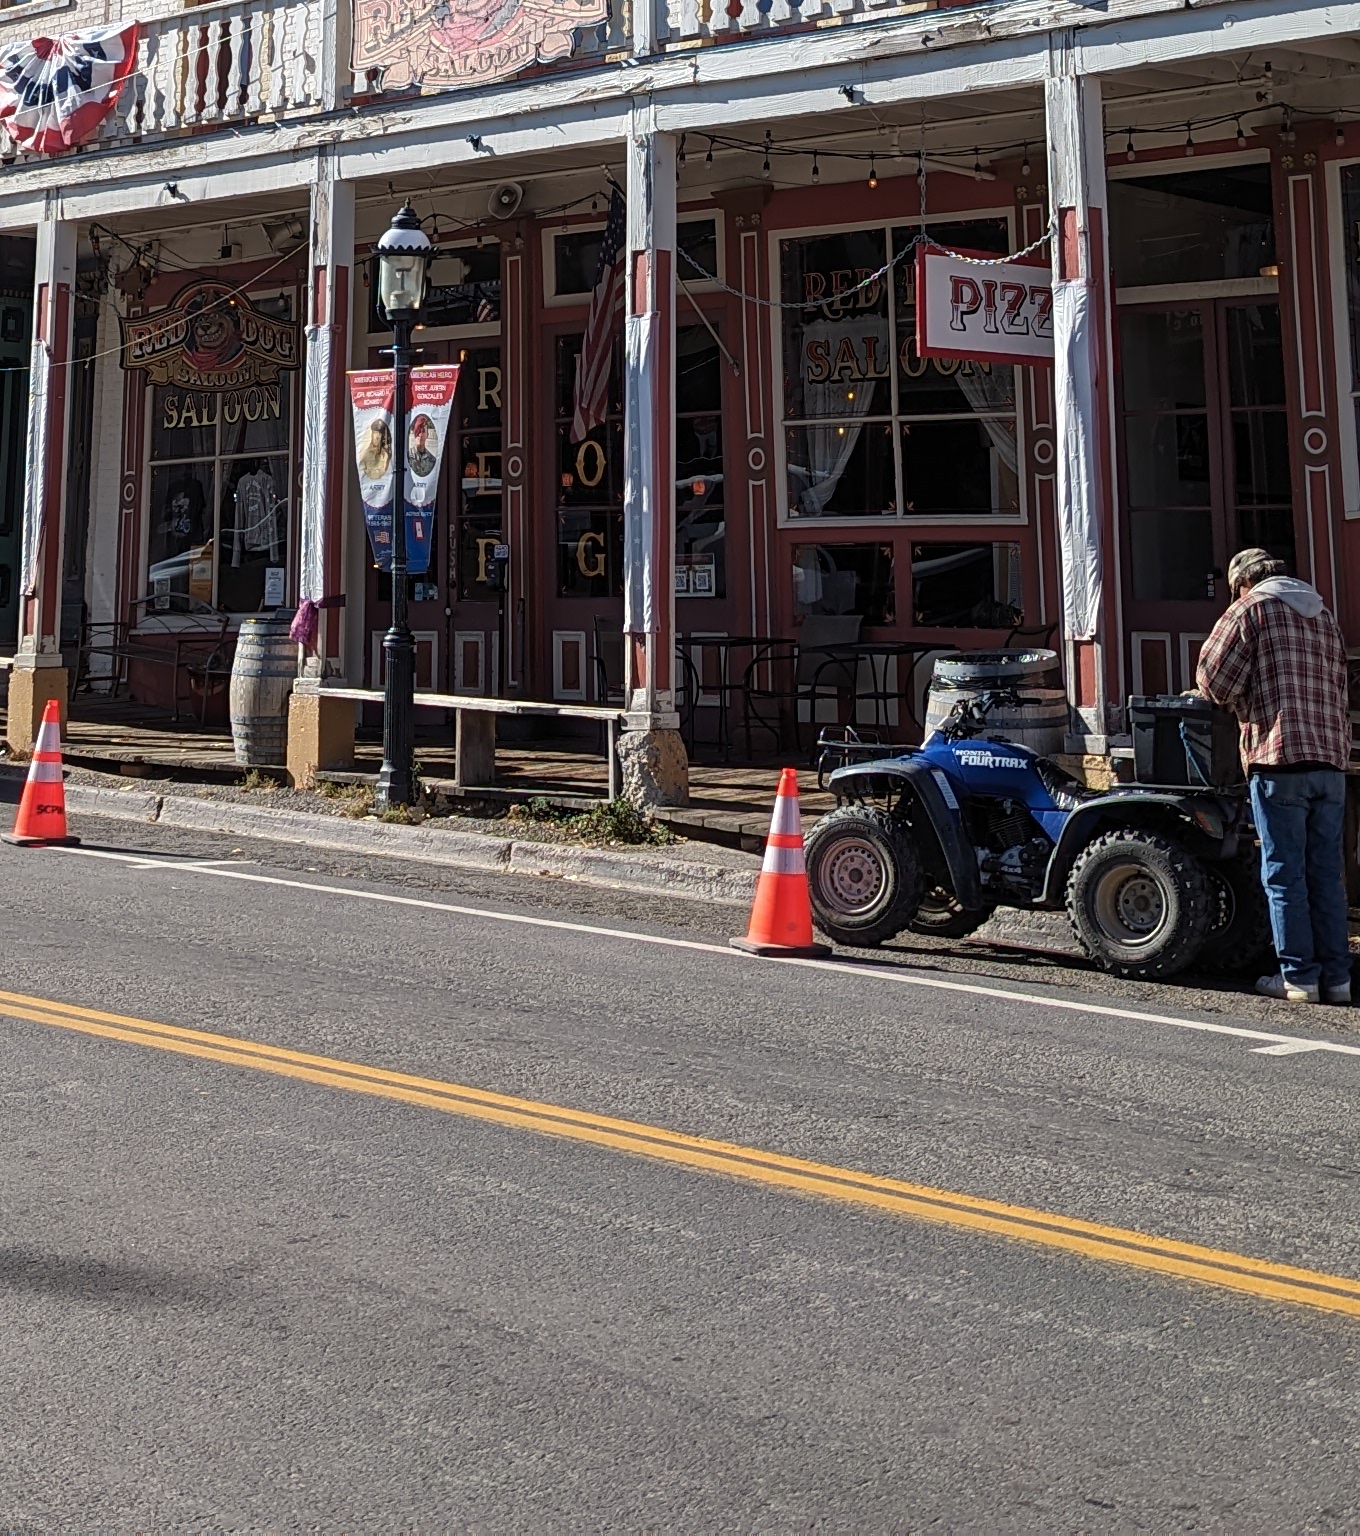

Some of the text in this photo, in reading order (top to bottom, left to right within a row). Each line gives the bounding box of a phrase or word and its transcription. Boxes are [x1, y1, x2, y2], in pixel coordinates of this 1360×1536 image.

[426, 35, 531, 78] SALOON
[804, 267, 882, 320] RED
[950, 275, 1054, 338] PIZZ
[131, 313, 295, 359] RED DOG
[177, 368, 252, 387] SALOON
[354, 375, 378, 383] AMERICAN
[163, 385, 283, 430] SALOON
[449, 524, 457, 579] PUSH
[960, 755, 1029, 769] FOURTRAX
